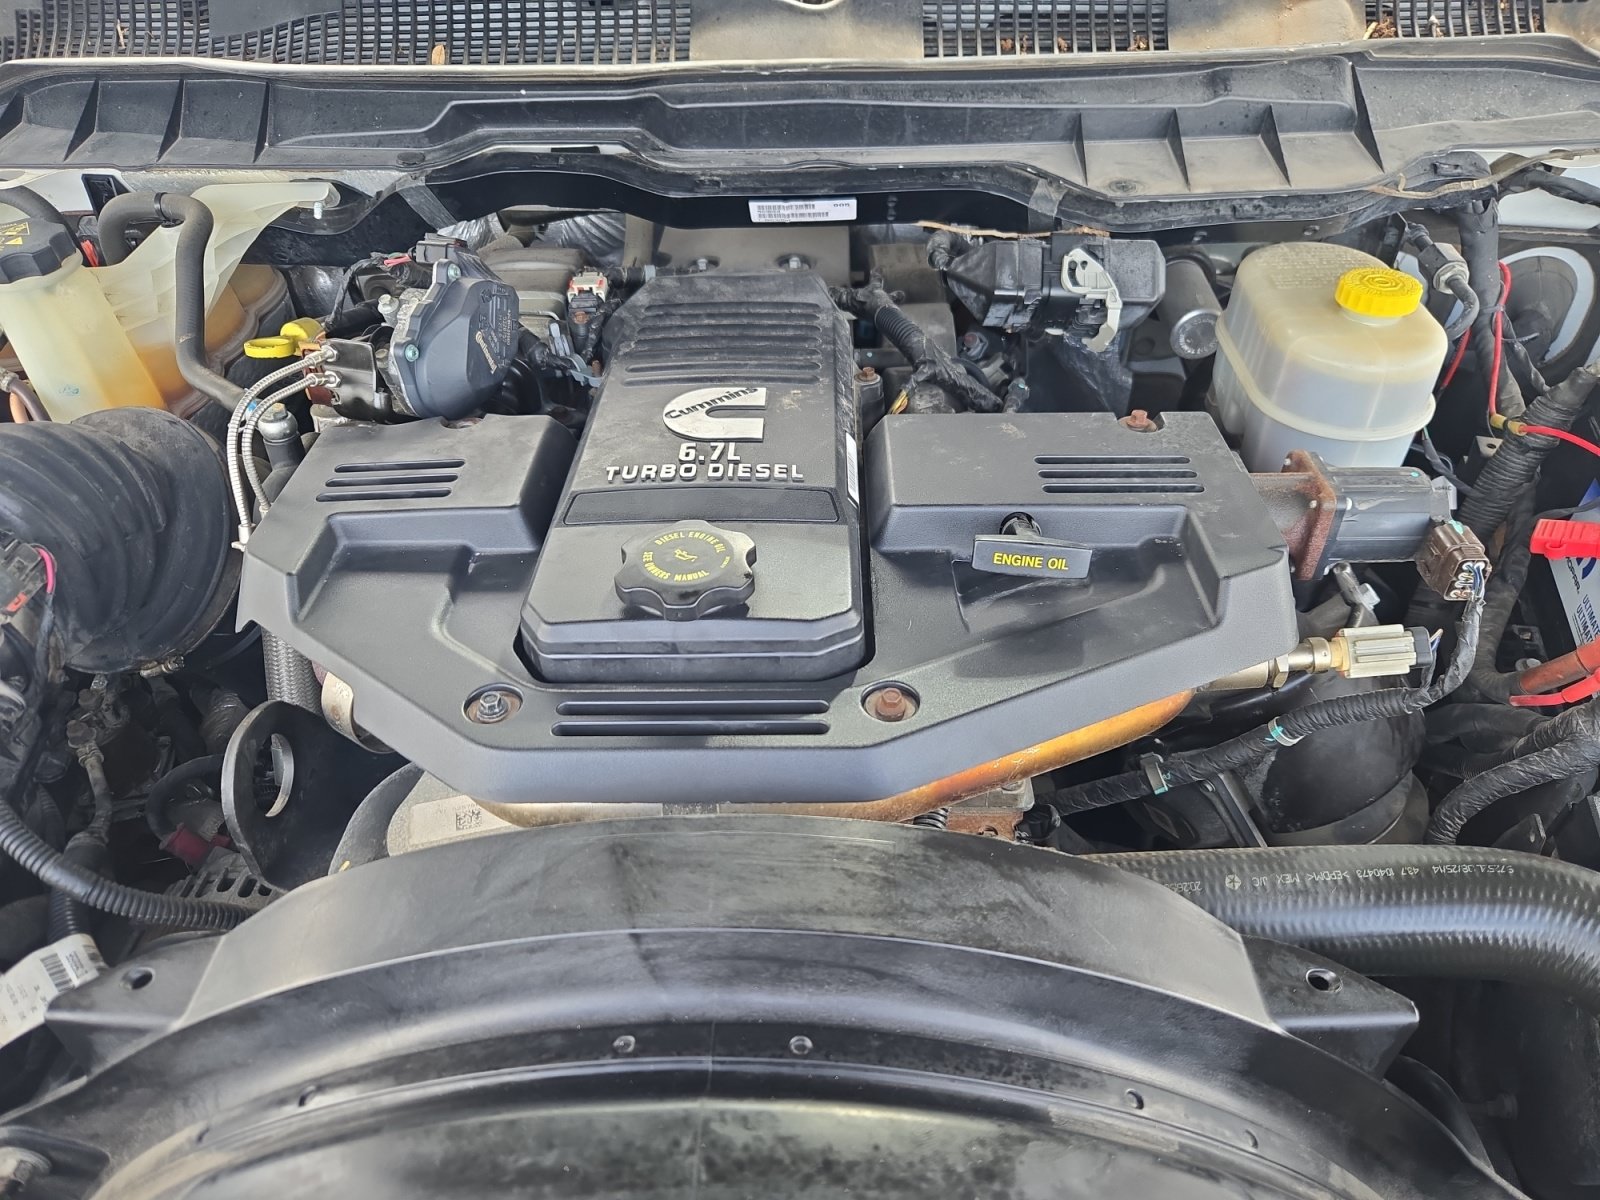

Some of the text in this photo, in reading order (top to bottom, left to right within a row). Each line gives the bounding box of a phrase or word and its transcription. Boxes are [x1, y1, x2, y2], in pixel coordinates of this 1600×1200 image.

[664, 387, 759, 419] Cummins
[678, 442, 741, 464] 6.7L
[606, 463, 805, 482] TURBO DIESEL
[654, 531, 686, 546] DIESEL
[688, 531, 720, 545] ENGINE
[642, 551, 654, 562] SEE
[673, 569, 710, 582] MANUAL
[993, 552, 1069, 570] ENGINE OIL
[1576, 603, 1595, 643] ULTIMAT
[1276, 873, 1301, 884] MEX
